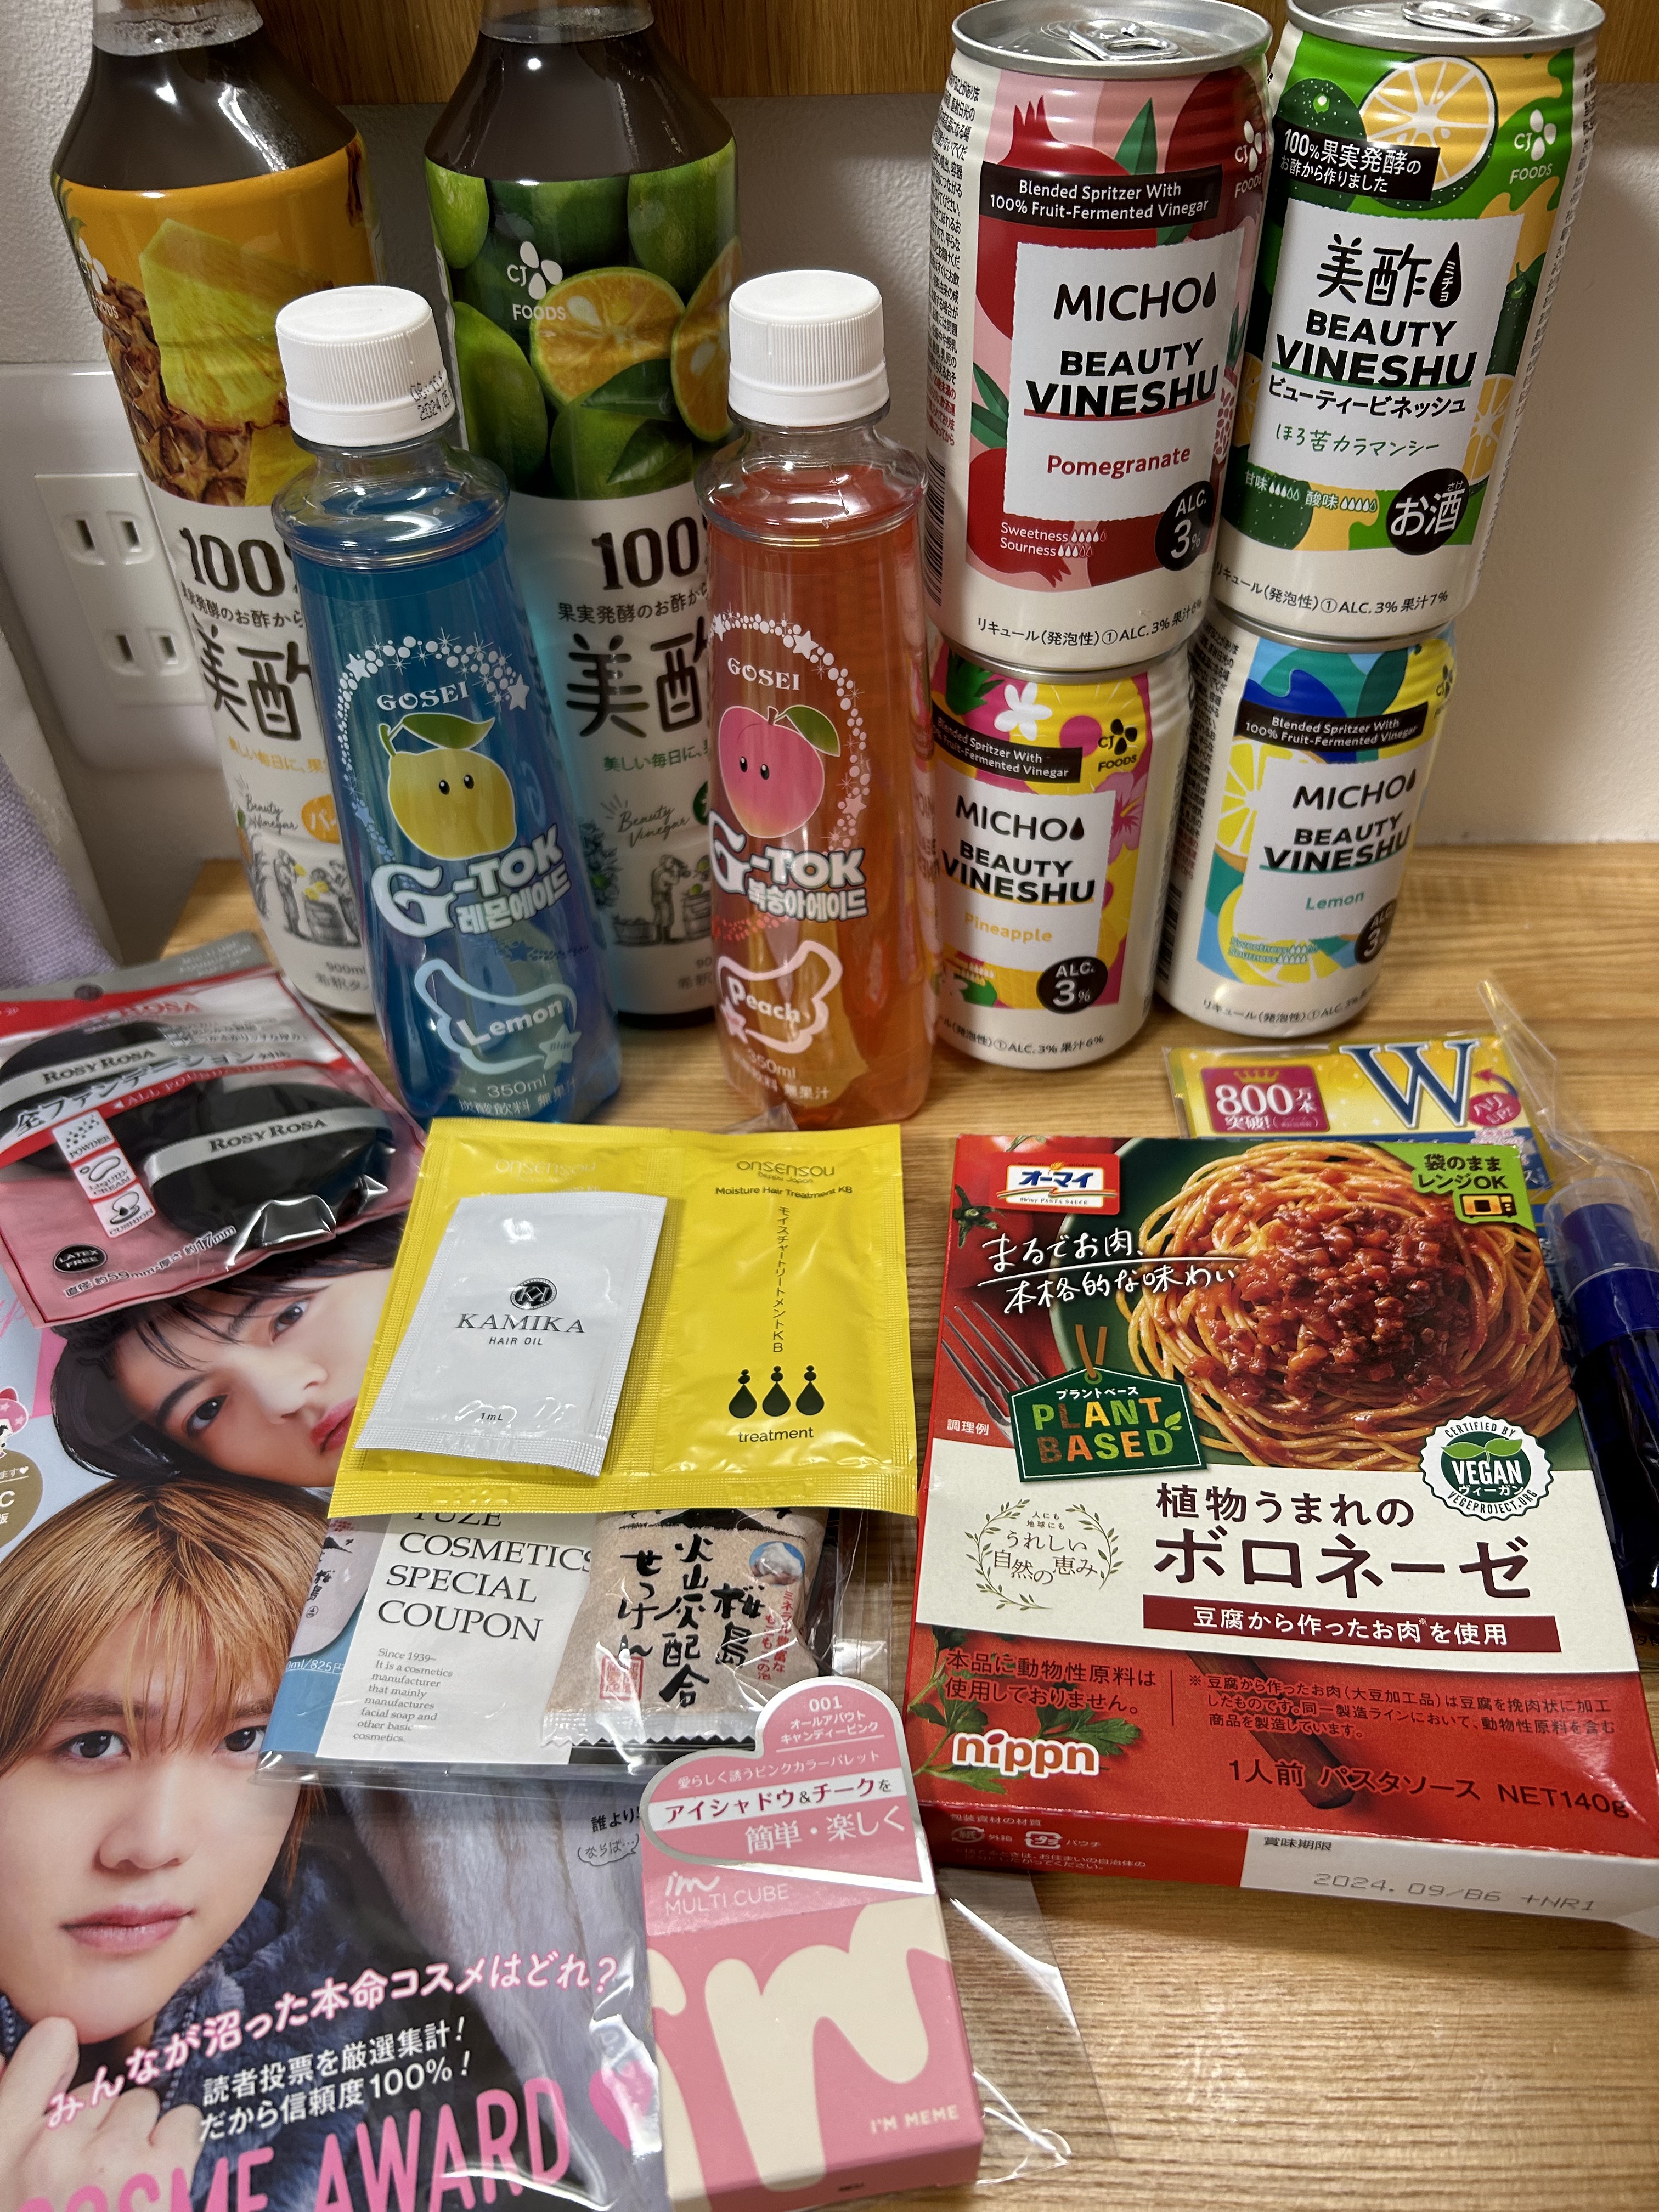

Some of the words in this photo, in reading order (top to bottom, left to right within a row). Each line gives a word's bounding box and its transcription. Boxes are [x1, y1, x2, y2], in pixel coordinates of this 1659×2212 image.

[1235, 145, 1248, 164] CJ
[1513, 133, 1533, 152] CJ
[1280, 154, 1388, 193] お酢から作りました
[1509, 164, 1553, 185] FOODS
[1019, 179, 1079, 199] Blended
[1082, 184, 1142, 201] Spritzer
[1147, 183, 1182, 198] With
[990, 194, 1027, 214] 100%
[1031, 202, 1153, 219] Fruit-Fermented
[1157, 199, 1208, 218] Vinegar
[507, 264, 527, 286] CJ
[1316, 233, 1433, 308] 美酢
[512, 304, 566, 321] FOODS
[1053, 277, 1201, 322] MICHO
[1305, 308, 1458, 348] BEAUTY
[1059, 338, 1204, 377] BEAUTY
[1276, 333, 1478, 388] VINESHU
[1025, 364, 1219, 418] VINESHU
[1269, 374, 1466, 420] ビューティービネッシュ
[1274, 423, 1440, 456] ほろ苦カラマンシー
[1047, 448, 1190, 479] Pomegranate
[1245, 470, 1268, 492] 甘味
[1305, 489, 1338, 510] 酸味
[1175, 489, 1207, 518] ALC.
[1390, 488, 1463, 537] お酒
[1001, 522, 1069, 543] Sweetness
[1170, 518, 1201, 559] 3%
[1000, 537, 1056, 557] Sourness
[1374, 601, 1397, 615] 3%
[1152, 618, 1170, 634] 3%
[727, 657, 800, 691] GOSEI
[377, 681, 470, 711] GOSEI
[1245, 722, 1278, 740] 100%
[1281, 731, 1378, 747] Fruit-Fermented
[1271, 716, 1321, 733] Blended
[1323, 723, 1370, 735] Spritzer
[1374, 718, 1400, 732] With
[969, 737, 1011, 759] Spritzer
[1013, 750, 1042, 764] With
[1098, 736, 1113, 749] CJ
[1023, 765, 1069, 779] Vinegar
[1098, 754, 1137, 772] FOODS
[1292, 775, 1406, 810] MICHO
[617, 804, 674, 833] Beauty
[956, 795, 1068, 842] MICHO
[1293, 810, 1403, 846] BEAUTY
[960, 840, 1073, 878] BEAUTY
[1263, 825, 1412, 872] VINESHU
[371, 824, 564, 938] G-TOK
[941, 849, 1096, 904] VINESHU
[456, 862, 572, 934] 레몬에이드
[747, 878, 869, 923] 복숭아에이드
[1305, 891, 1364, 911] Lemon
[964, 912, 1053, 944] Pineapple
[1056, 963, 1096, 978] ALC.
[727, 977, 800, 1023] Peach
[1052, 979, 1091, 1008] 3%
[456, 1000, 564, 1046] Lemon
[487, 1075, 548, 1098] 350ml
[1339, 1040, 1481, 1130] W
[69, 1135, 111, 1159] POWDER
[1424, 1153, 1502, 1172] 袋のまま
[1019, 1170, 1094, 1188] オーマイ
[1418, 1173, 1508, 1190] レンジOK
[716, 1187, 760, 1195] Moisture
[763, 1186, 782, 1194] Hair
[785, 1188, 836, 1199] Treatment
[1005, 1263, 1236, 1314] 本格的な味わい
[455, 1313, 585, 1333] KAMIKA
[488, 1336, 517, 1345] HAIR
[524, 1336, 543, 1345] OIL
[1056, 1386, 1139, 1400] プラントベース
[480, 1410, 504, 1421] 1mL
[1032, 1396, 1163, 1431] PLANT
[738, 1426, 814, 1443] treatment
[946, 1419, 989, 1435] 調理例
[1444, 1421, 1497, 1438] CERTIFIED
[1502, 1426, 1516, 1437] BY
[1037, 1429, 1173, 1464] BASED
[1451, 1459, 1523, 1485] VEGAN
[1447, 1488, 1538, 1514] VEGEPROJECT.ORG
[1458, 1484, 1524, 1496] ヴィーガン
[1032, 1511, 1060, 1520] 人にも
[1156, 1482, 1414, 1527] 植物うまれの
[1026, 1520, 1064, 1530] 地球にも
[1006, 1530, 1087, 1551] うれしい
[993, 1549, 1098, 1585] 自然の恵み
[1154, 1525, 1531, 1599] ボロネーゼ
[386, 1564, 537, 1603] SPECIAL
[378, 1600, 544, 1642] COUPON
[378, 1647, 405, 1661] Since
[371, 1672, 441, 1688] manufacturer
[375, 1660, 383, 1670] It
[385, 1662, 394, 1671] is
[404, 1664, 453, 1678] cosmetics
[947, 1649, 1156, 1687] 本品に動物性原料は
[365, 1697, 435, 1710] manufactures
[368, 1684, 388, 1695] that
[390, 1687, 427, 1700] mainly
[809, 1696, 843, 1713] 001
[945, 1677, 1138, 1715] 使用しておりません。
[357, 1720, 385, 1730] other
[387, 1721, 413, 1731] basic
[361, 1708, 389, 1719] facial
[390, 1712, 415, 1722] soap
[417, 1712, 438, 1722] and
[791, 1710, 866, 1730] オールアバウト
[781, 1721, 879, 1745] キャンディーピンク
[956, 1731, 1096, 1775] nippn
[1229, 1759, 1304, 1788] 1人前
[1319, 1767, 1481, 1802] パスタソース
[746, 1805, 906, 1854] 簡単・楽しく
[1263, 1836, 1333, 1852] 賞味期限
[665, 1892, 726, 1916] MULTI
[734, 1883, 790, 1907] CUBE
[1520, 1893, 1595, 1913] +NR1
[871, 2117, 898, 2136] I'M
[904, 2104, 960, 2129] MEME
[315, 2077, 572, 2212] AWARD
